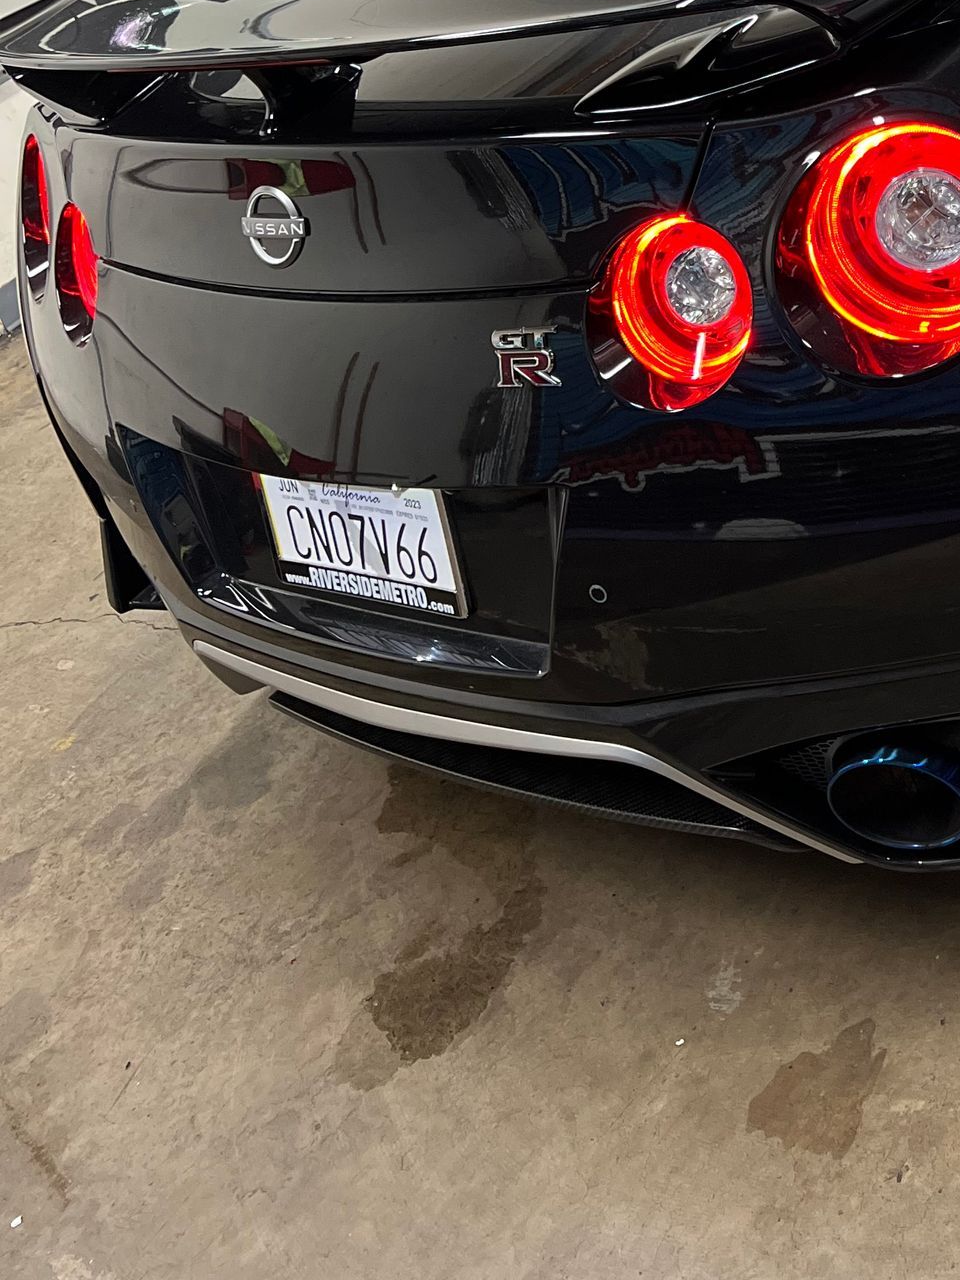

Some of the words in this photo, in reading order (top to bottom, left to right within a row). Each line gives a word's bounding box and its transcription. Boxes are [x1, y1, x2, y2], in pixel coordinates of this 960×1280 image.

[242, 221, 304, 235] NISSAN
[279, 479, 299, 494] JUN
[321, 482, 381, 507] California
[403, 498, 421, 510] 2023
